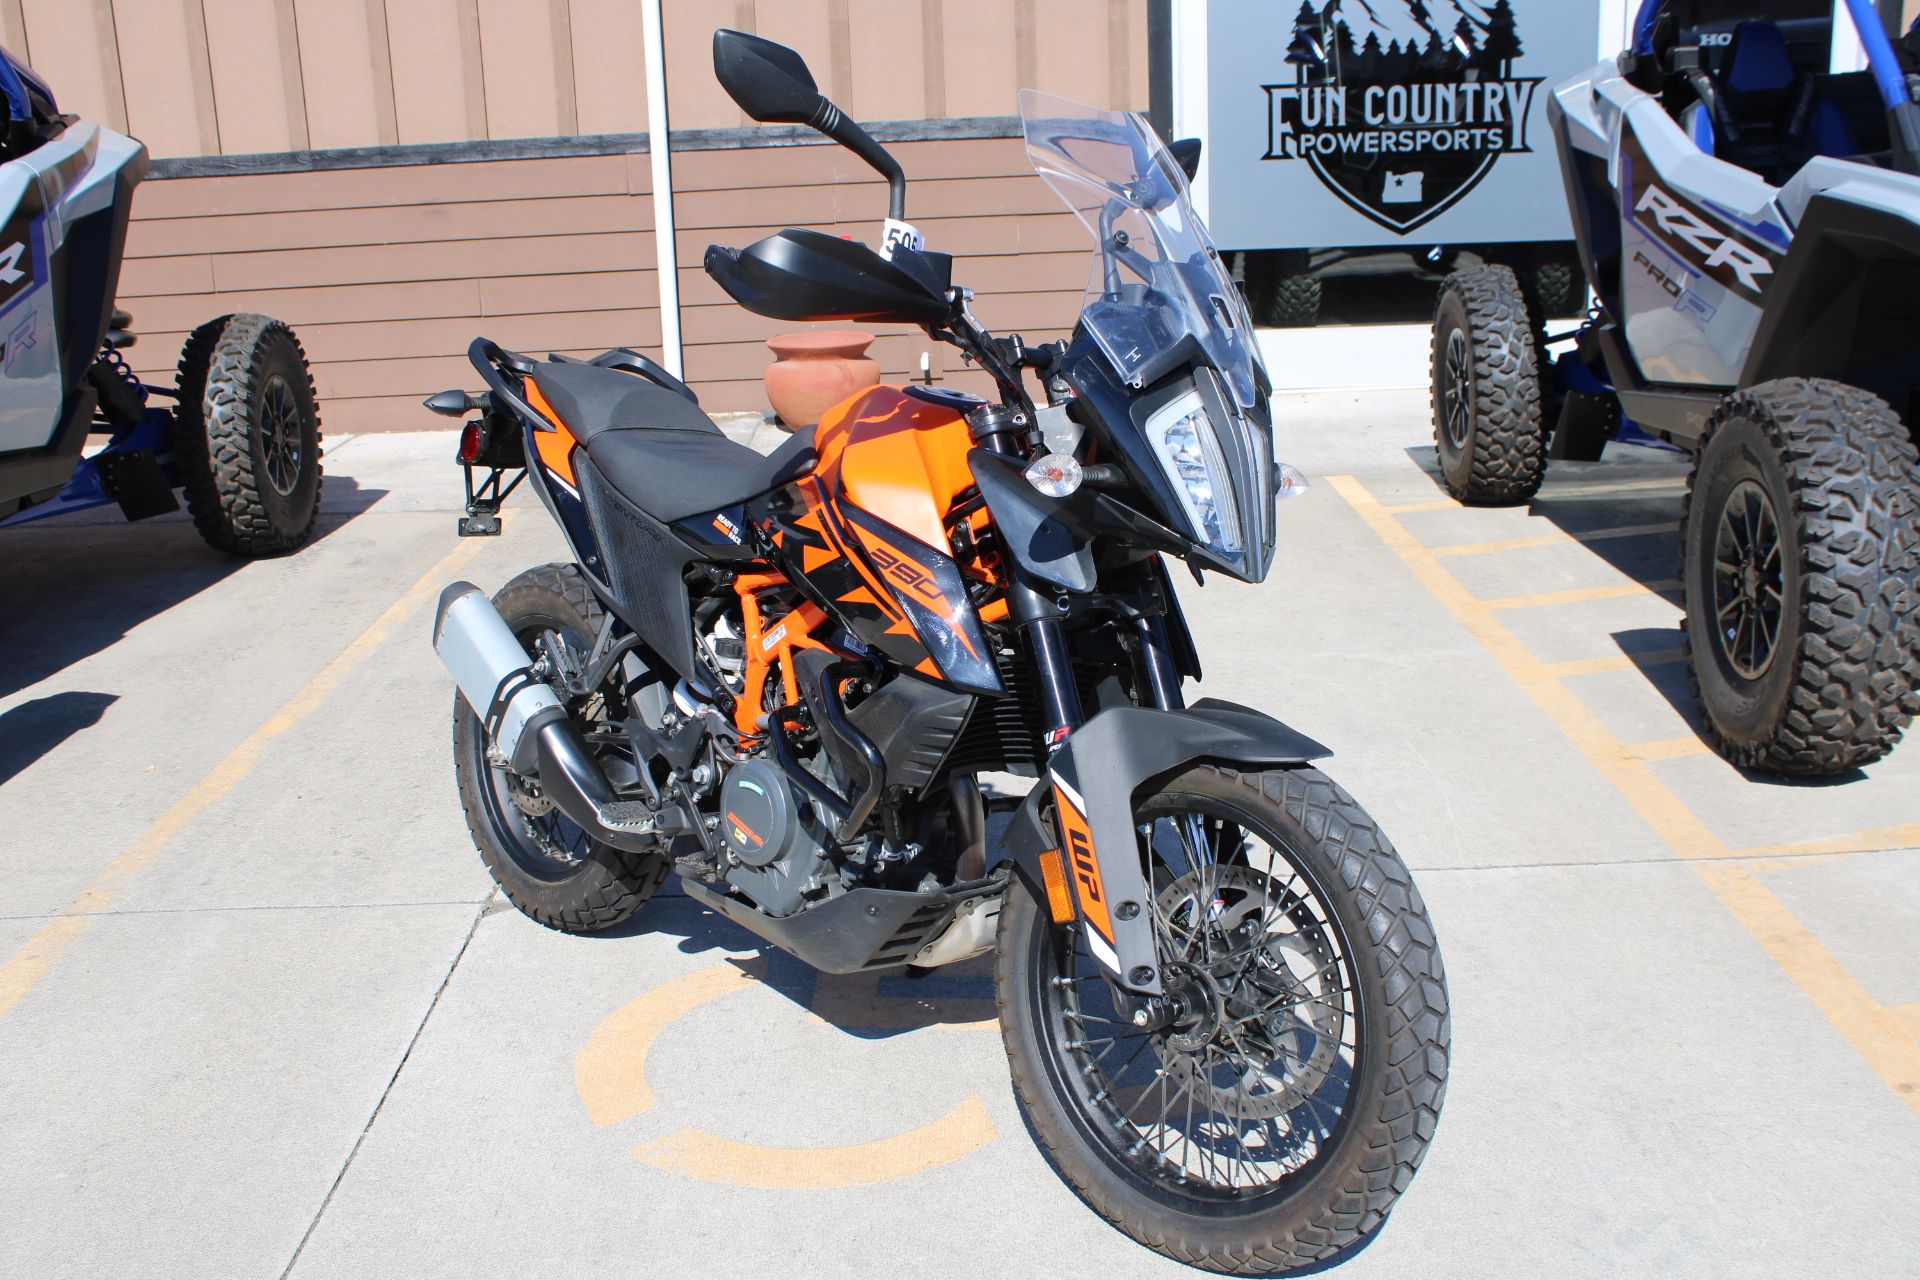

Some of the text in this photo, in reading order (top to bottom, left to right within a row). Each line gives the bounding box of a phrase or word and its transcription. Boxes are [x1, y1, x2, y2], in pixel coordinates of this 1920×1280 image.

[1269, 80, 1535, 157] FUN COUNTRY
[1299, 127, 1504, 156] POWERSPORTS
[1634, 183, 1774, 293] RZR
[1633, 251, 1683, 298] PRO
[716, 513, 733, 531] READY
[727, 531, 742, 546] RACE
[870, 548, 945, 600] 390
[1068, 828, 1101, 903] WP
